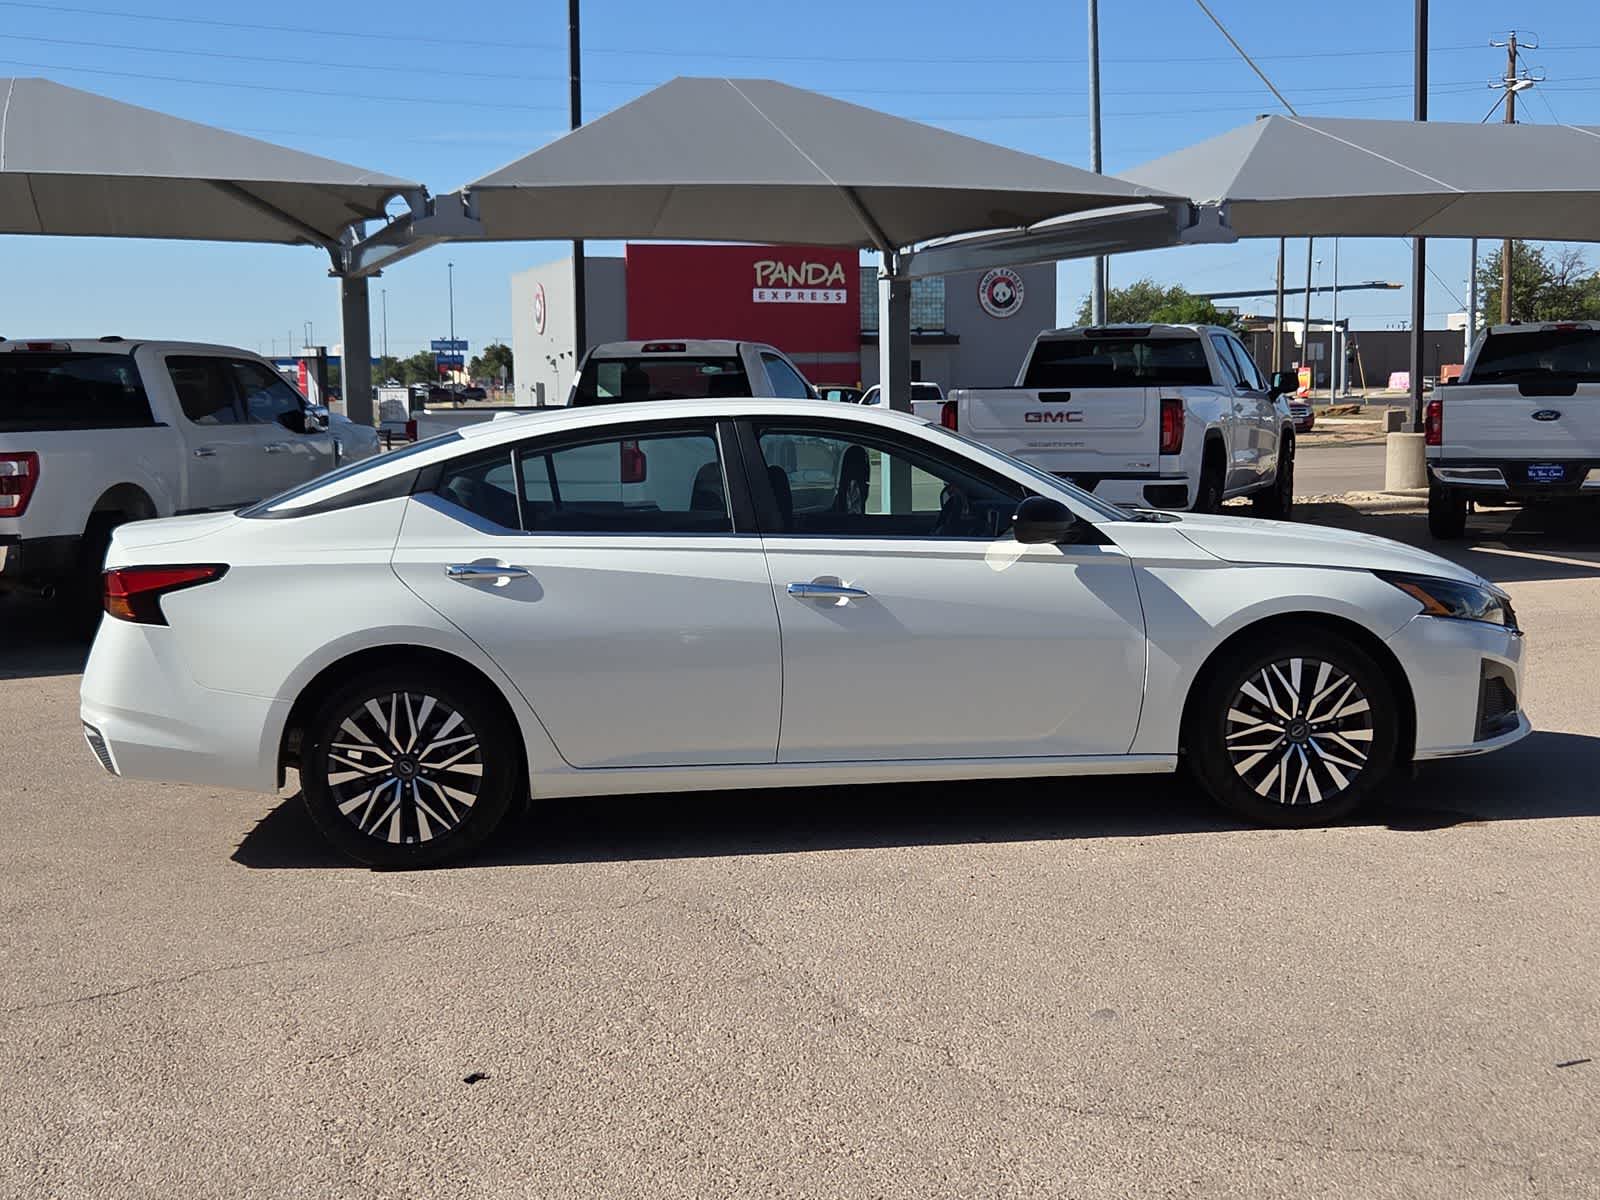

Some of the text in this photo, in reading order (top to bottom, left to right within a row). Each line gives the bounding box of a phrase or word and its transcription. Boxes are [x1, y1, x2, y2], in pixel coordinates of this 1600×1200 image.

[753, 261, 846, 287] PANDA
[758, 291, 842, 301] EXPRESS
[1024, 411, 1084, 423] GMC
